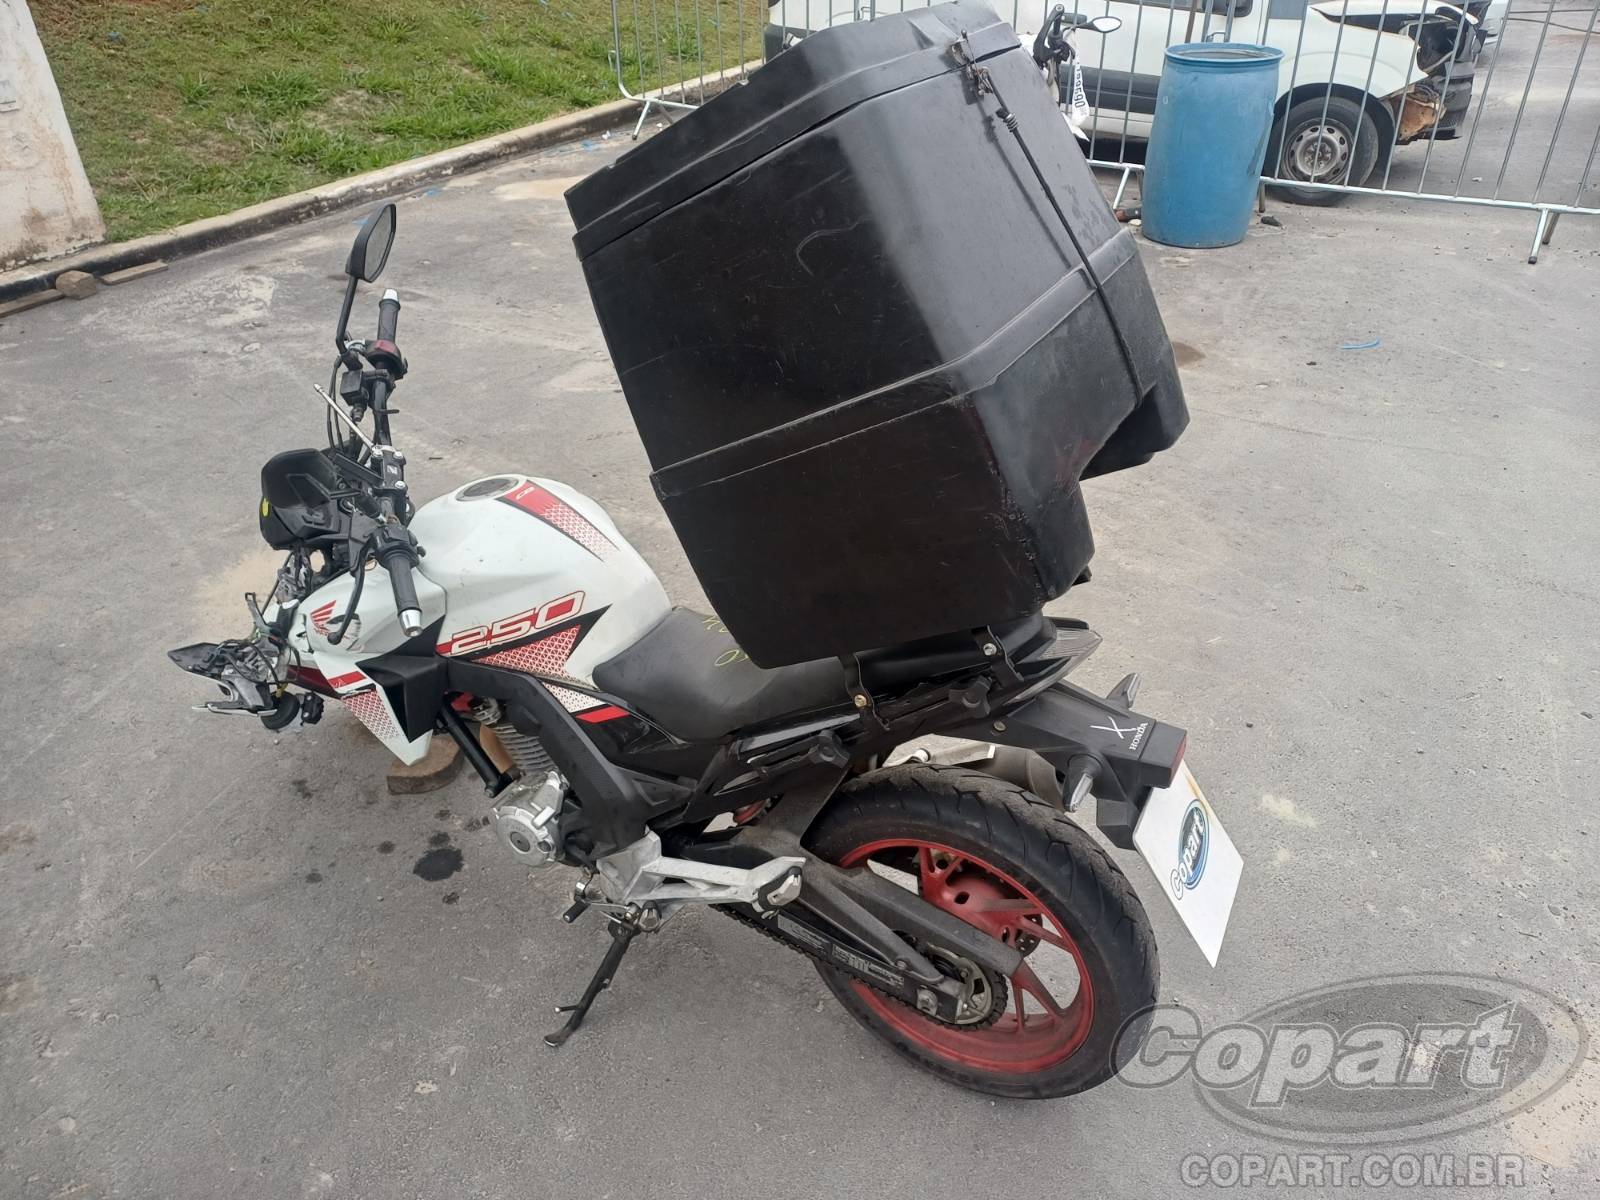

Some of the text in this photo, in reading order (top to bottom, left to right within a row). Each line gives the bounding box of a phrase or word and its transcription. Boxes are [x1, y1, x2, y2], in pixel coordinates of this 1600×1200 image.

[450, 590, 586, 655] 250
[1128, 722, 1149, 751] HONDA
[1170, 807, 1204, 901] Copart
